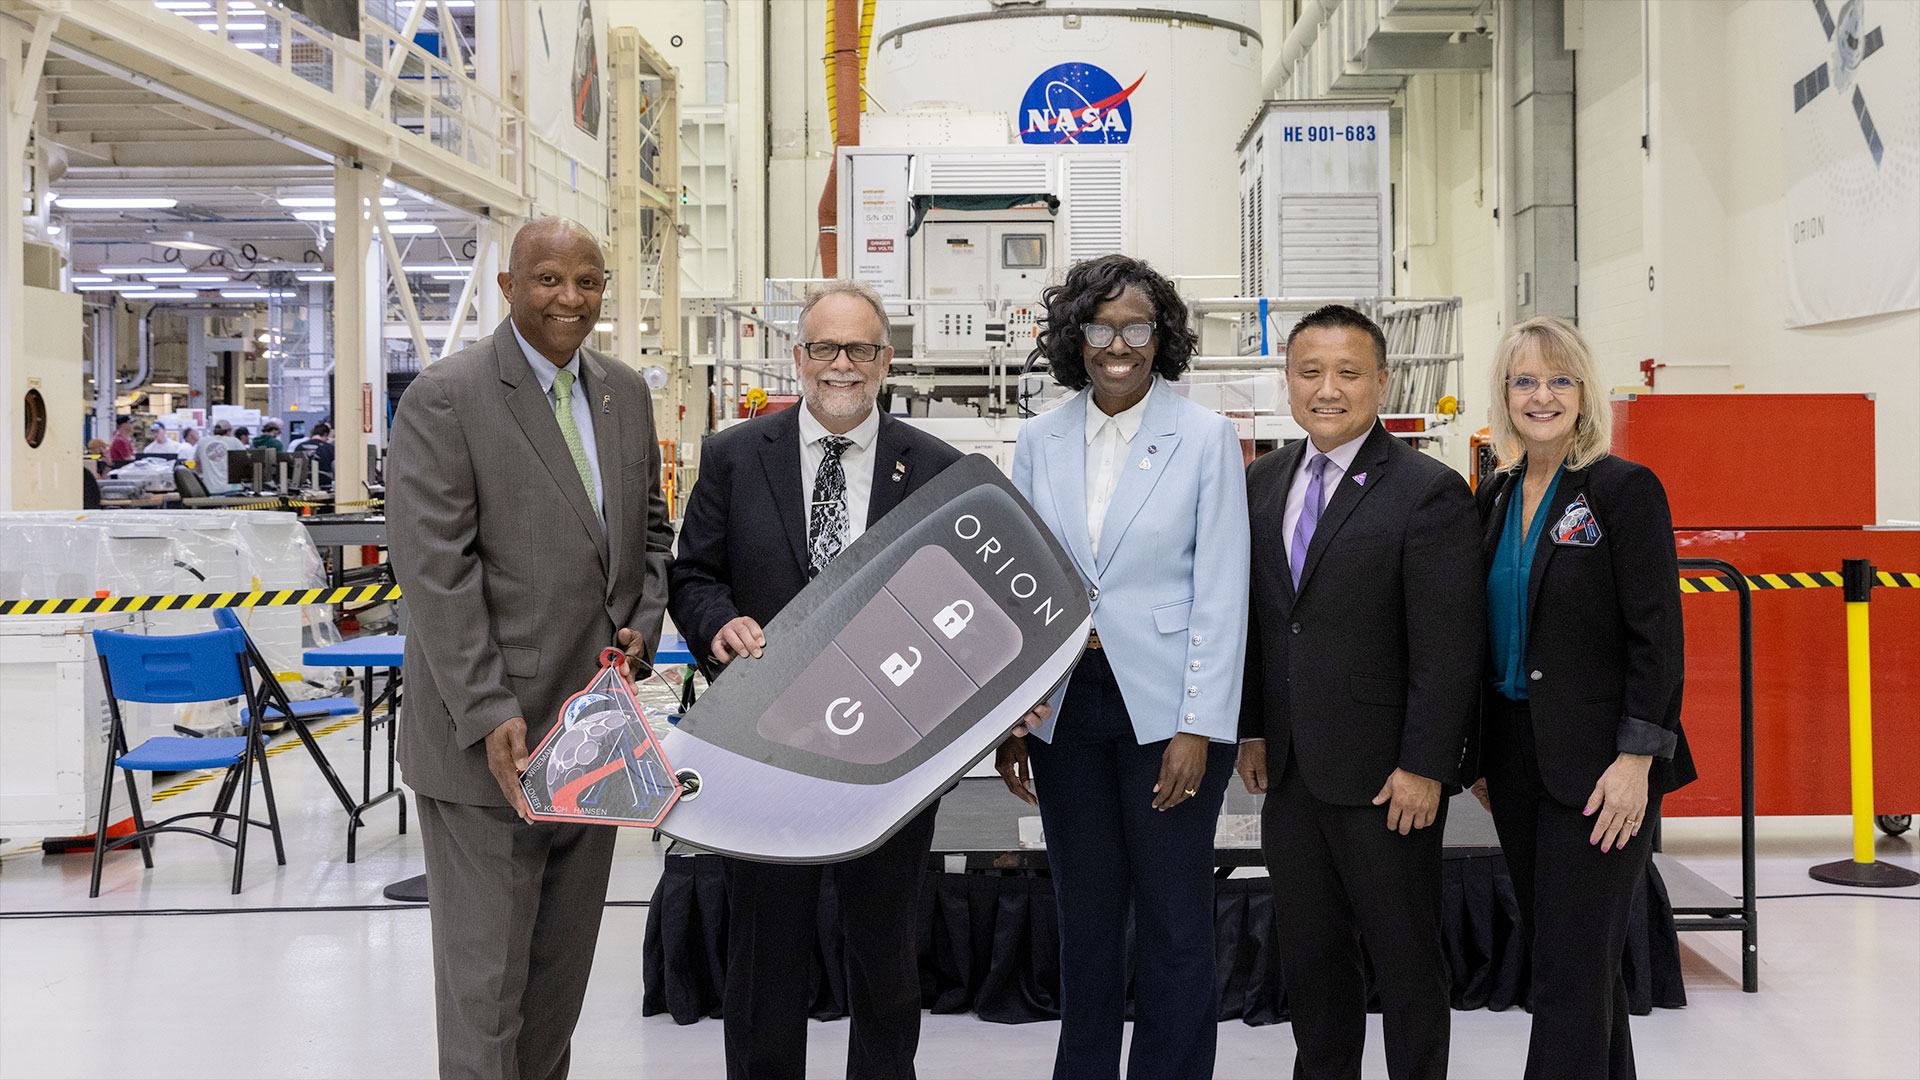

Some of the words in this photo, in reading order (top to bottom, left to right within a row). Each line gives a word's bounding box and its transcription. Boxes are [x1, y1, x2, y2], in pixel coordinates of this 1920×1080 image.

[1027, 108, 1127, 132] NASA
[1284, 127, 1303, 142] HE
[1308, 125, 1376, 142] 901-683
[866, 214, 880, 222] S/N
[1793, 215, 1825, 244] ORION
[1648, 265, 1655, 292] 6
[955, 515, 1064, 627] ORION
[526, 746, 555, 778] WISEMAN
[523, 779, 542, 810] GLOVER
[544, 805, 568, 813] KOCH
[574, 807, 608, 816] HANSEN
